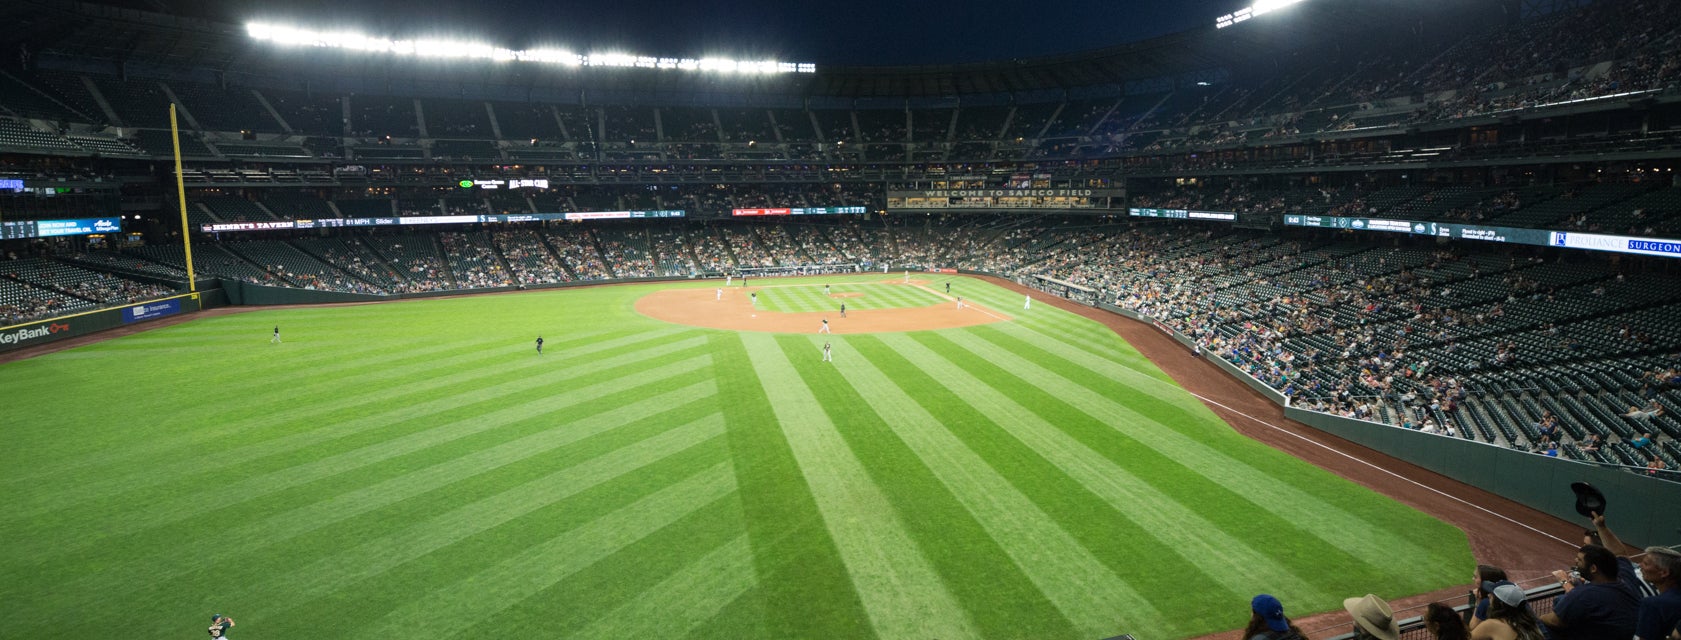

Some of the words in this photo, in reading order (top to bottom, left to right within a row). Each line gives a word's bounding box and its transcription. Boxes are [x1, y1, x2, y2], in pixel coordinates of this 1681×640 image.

[212, 223, 254, 231] HENRY'S
[256, 221, 294, 229] TAVERN
[1569, 235, 1624, 248] PROLIANCE
[1629, 240, 1681, 253] SURGEON
[0, 325, 50, 345] KeyBank
